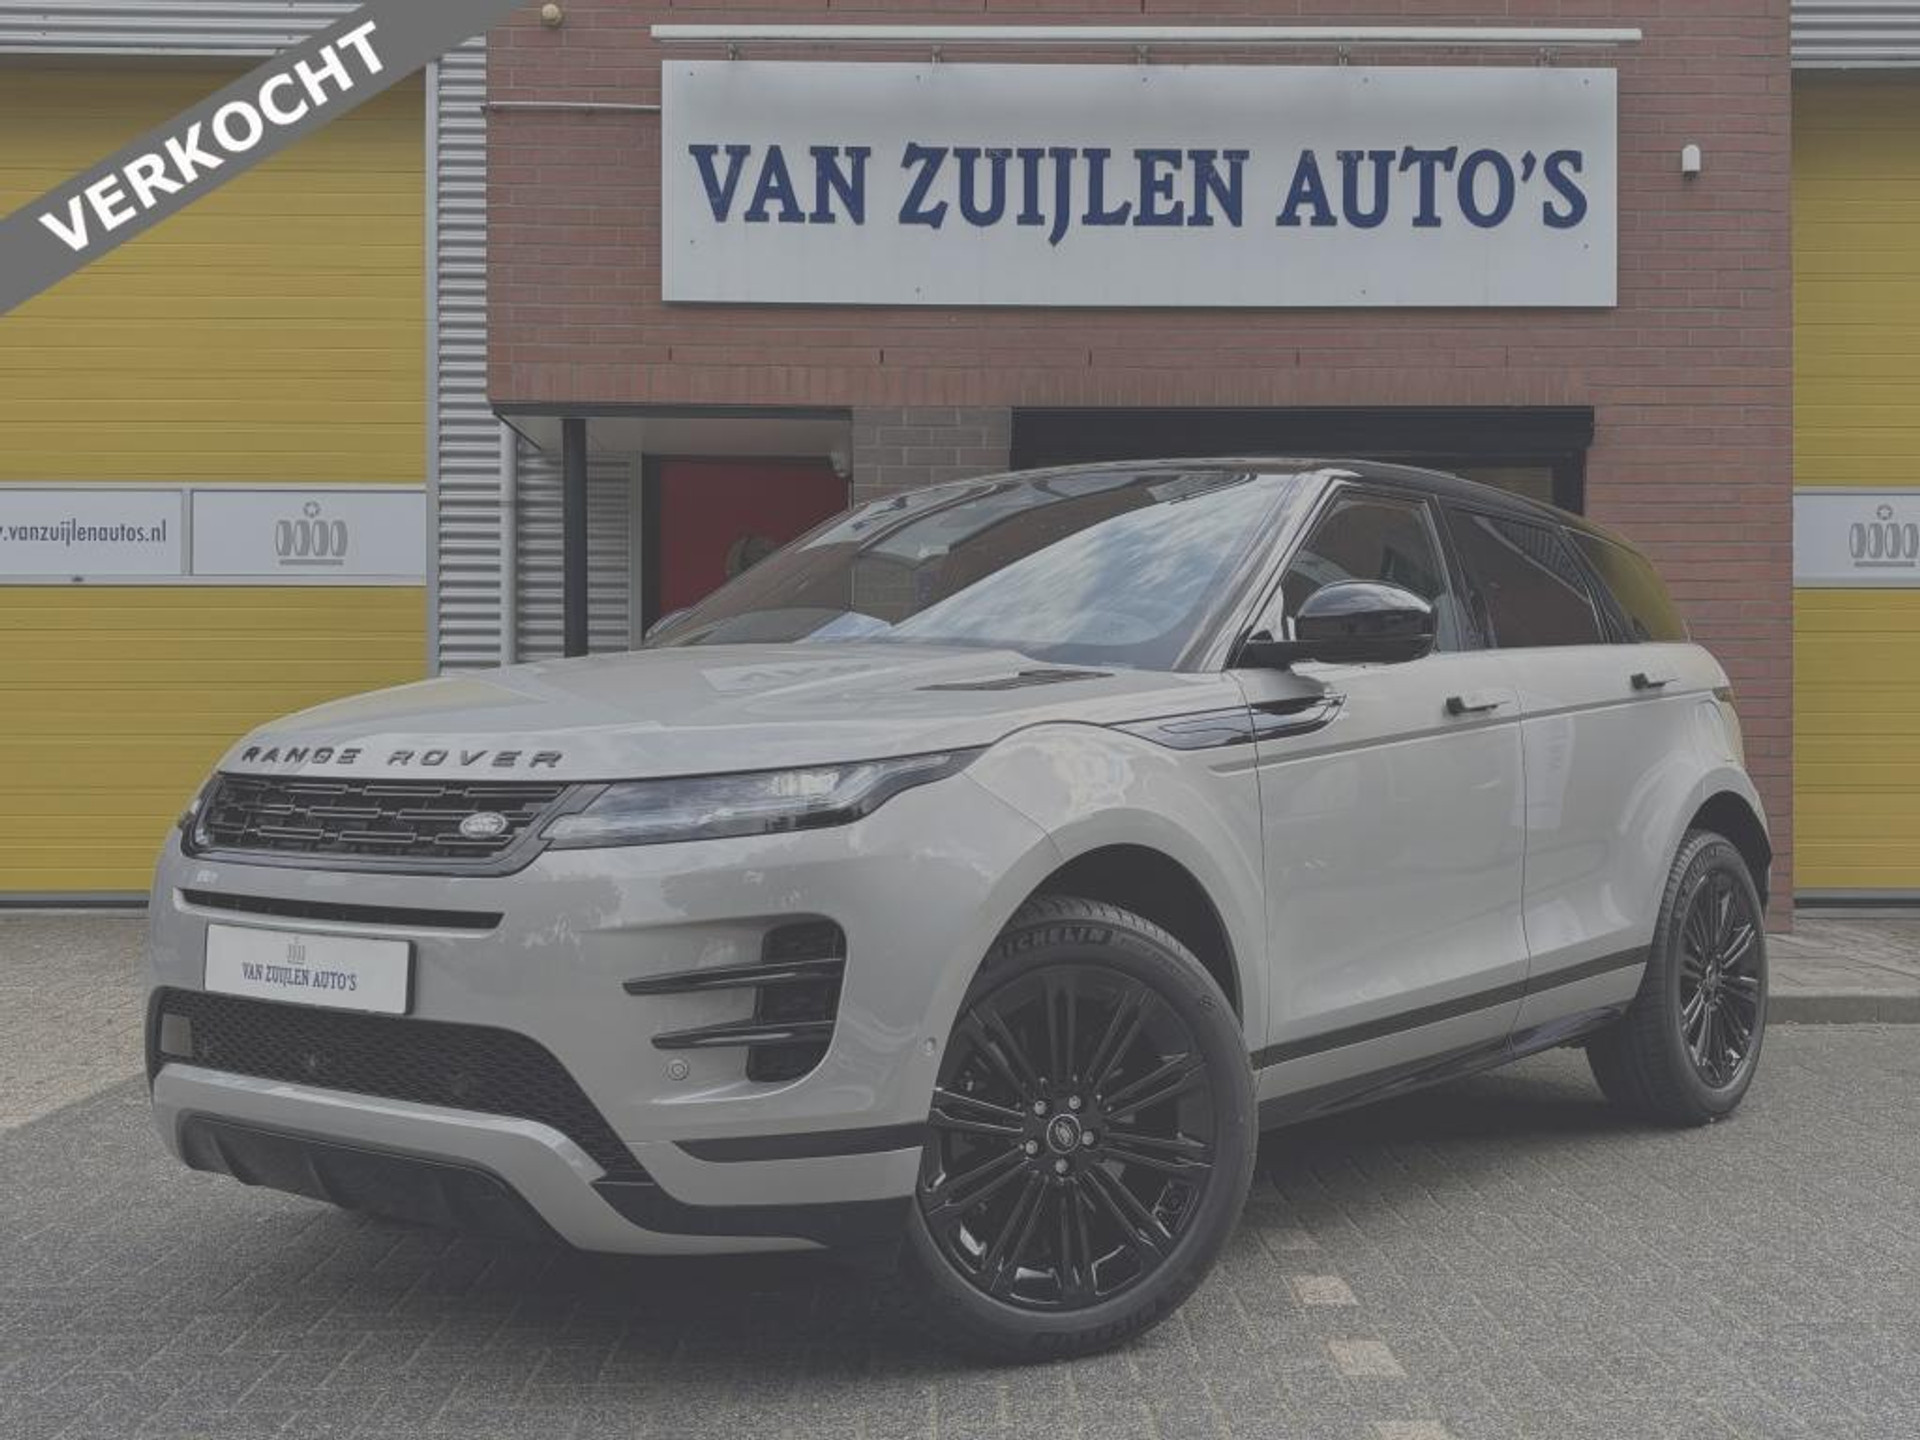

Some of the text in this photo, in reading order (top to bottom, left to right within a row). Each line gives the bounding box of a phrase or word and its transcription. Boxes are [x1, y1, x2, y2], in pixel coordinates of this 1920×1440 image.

[689, 141, 1589, 245] VAN ZUIJLEN AUTO'S
[0, 518, 167, 547] .vanzuijlenautos.nl
[241, 746, 563, 769] RANGE ROVER
[242, 961, 357, 991] VAN ZUIJLEN AUTO'S
